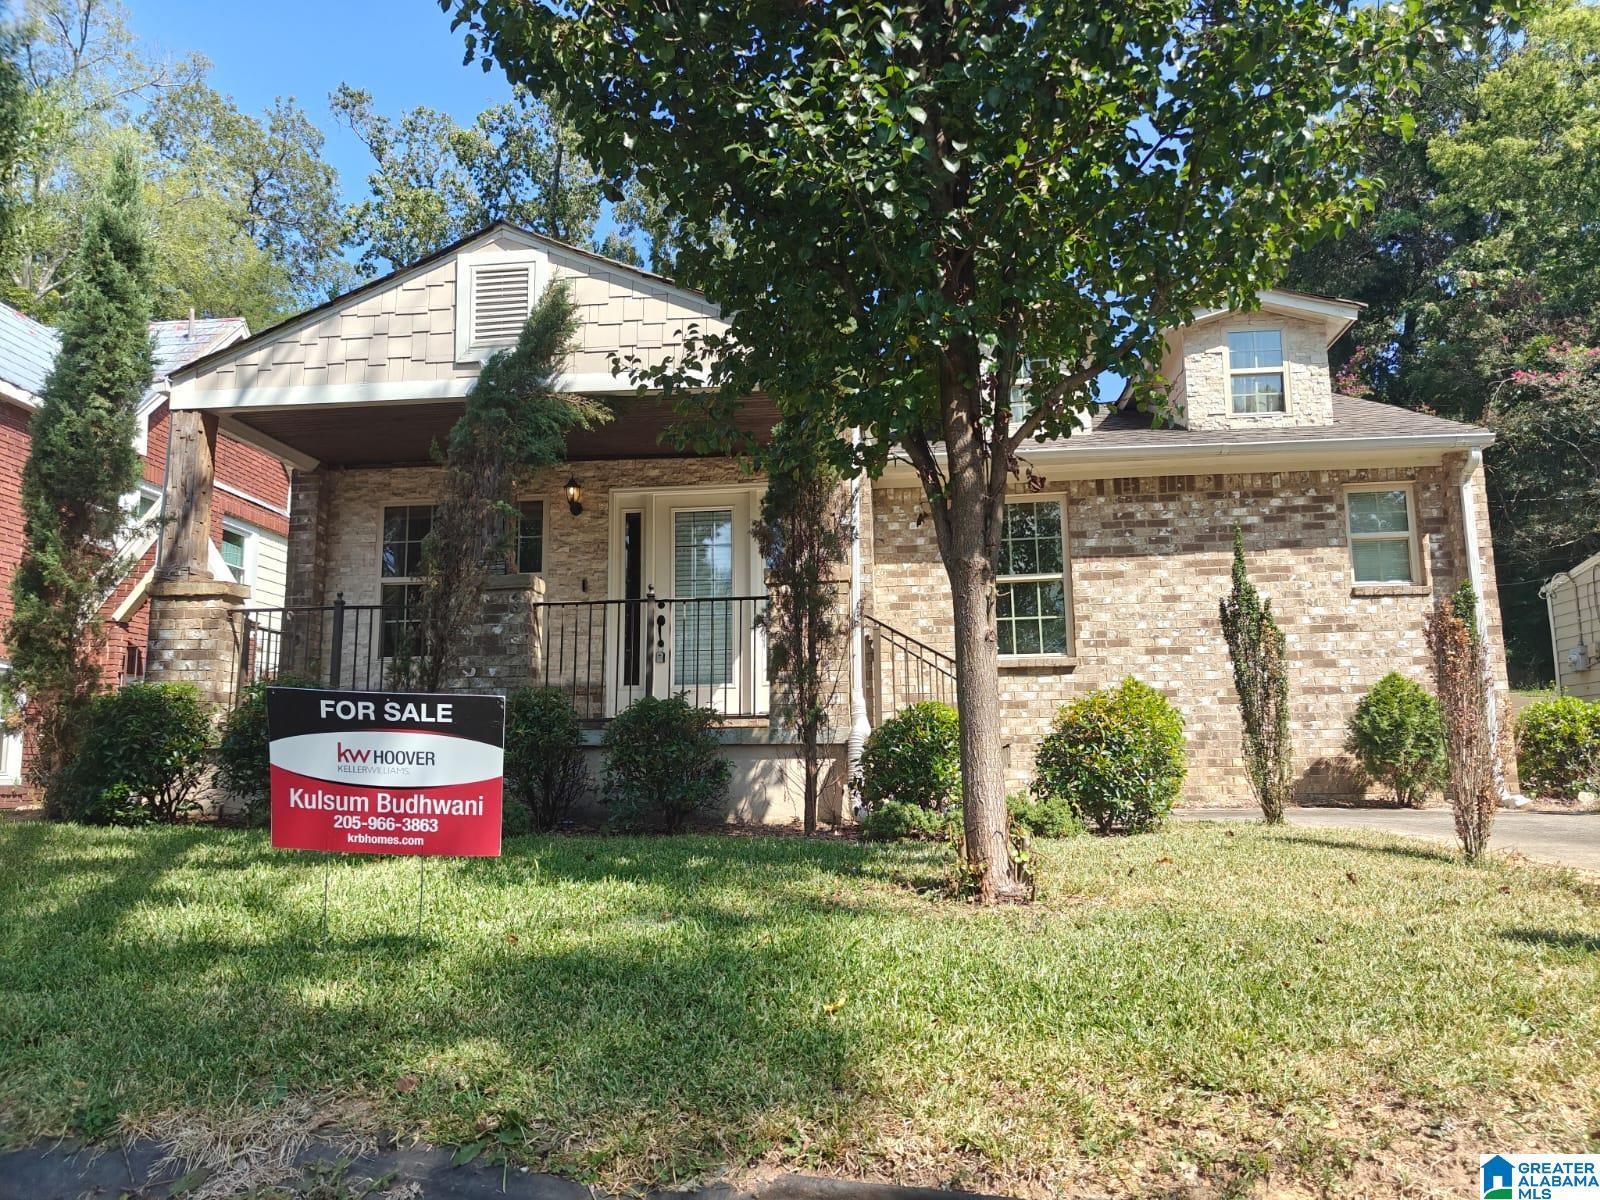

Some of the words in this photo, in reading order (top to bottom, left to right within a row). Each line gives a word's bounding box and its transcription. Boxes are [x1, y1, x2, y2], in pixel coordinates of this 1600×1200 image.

[320, 700, 376, 720] FOR
[384, 702, 453, 723] SALE
[374, 750, 435, 766] HOOVER
[289, 788, 369, 813] Kulsum
[377, 793, 483, 816] Budhwani
[334, 815, 438, 832] 205-966-3863
[348, 833, 424, 846] krbhomes.com
